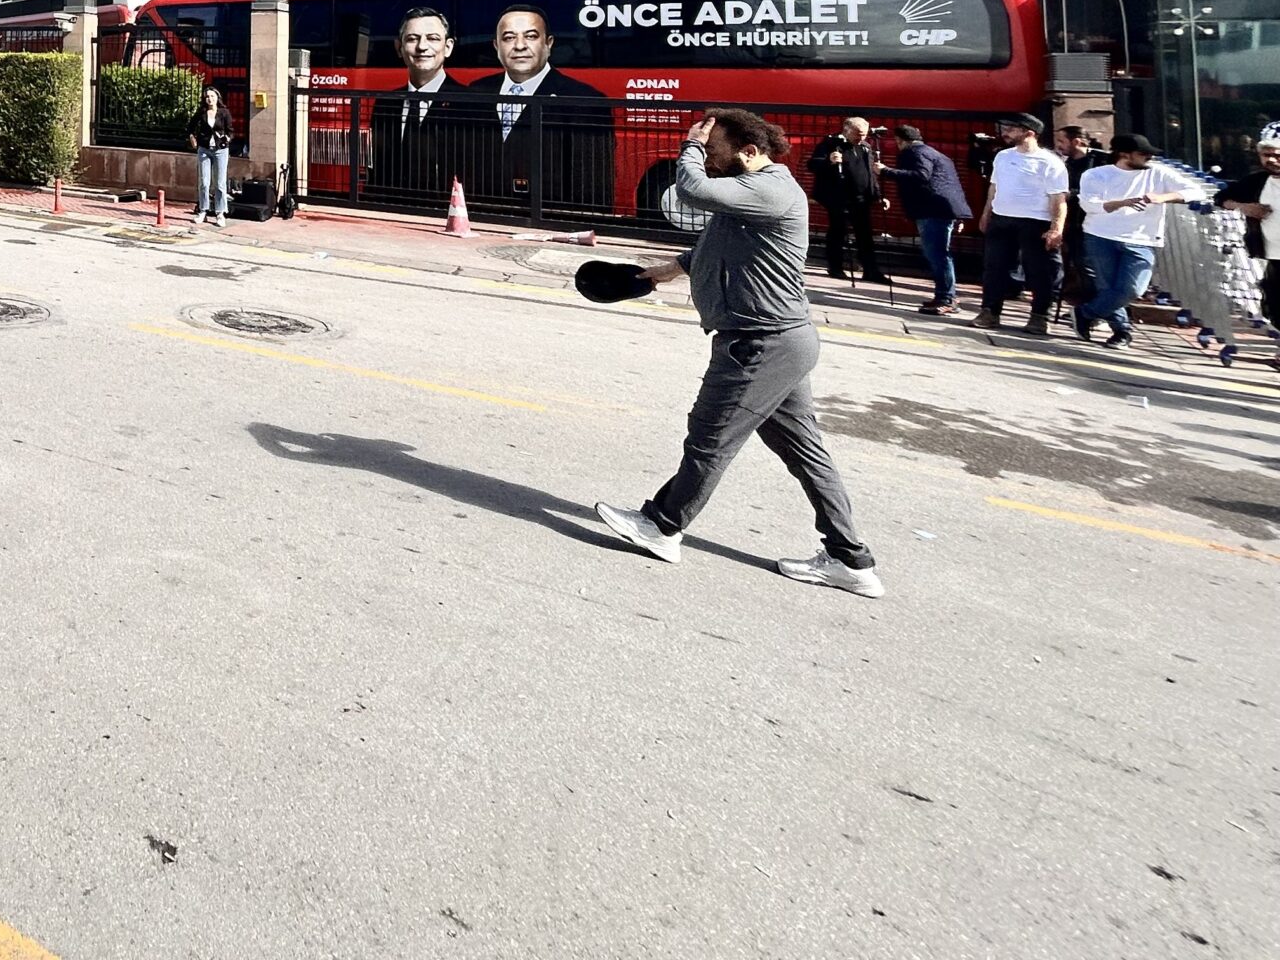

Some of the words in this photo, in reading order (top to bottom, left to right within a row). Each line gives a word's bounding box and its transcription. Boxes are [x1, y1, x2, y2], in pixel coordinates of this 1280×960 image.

[578, 0, 683, 28] ÖNCE
[667, 29, 731, 47] ÖNCE
[737, 27, 868, 47] HÜRRİYET!
[899, 29, 957, 46] CHP
[311, 74, 348, 85] ÖZGÜR
[626, 78, 680, 89] ADNAN
